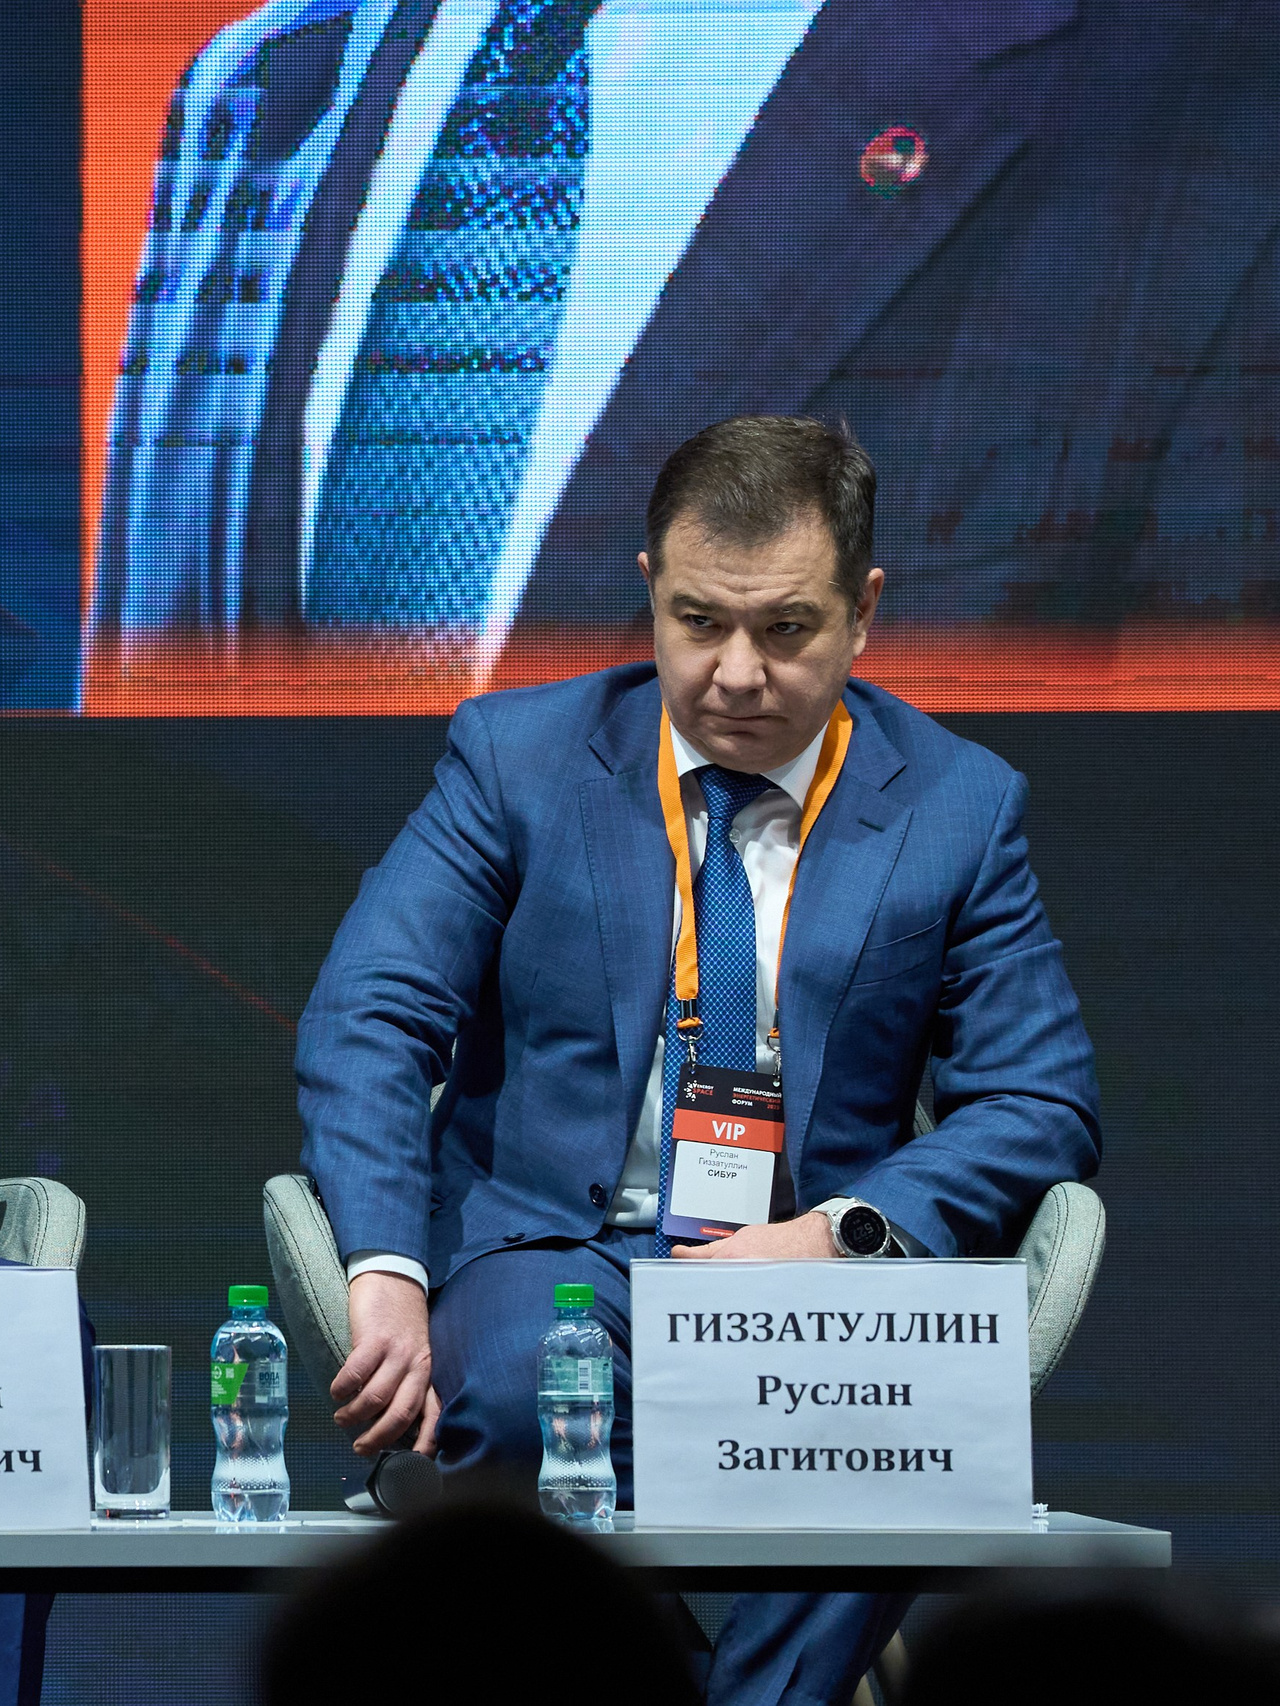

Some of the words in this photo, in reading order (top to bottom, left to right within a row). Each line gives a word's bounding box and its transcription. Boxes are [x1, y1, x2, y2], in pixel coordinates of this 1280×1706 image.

[692, 1088, 714, 1096] SPACE
[733, 1087, 782, 1098] МЕЖДУНАРОДНЫЙ
[731, 1099, 753, 1107] ФОРУМ
[712, 1120, 746, 1141] VIP
[710, 1148, 739, 1159] Руслан
[699, 1156, 748, 1170] Гиззатуллин
[707, 1169, 738, 1179] СИБУР
[666, 1311, 1000, 1345] ГИЗЗАТУЛЛИН
[259, 1371, 280, 1381] ВОДА
[756, 1375, 913, 1415] Руслан
[717, 1439, 955, 1473] Загитович
